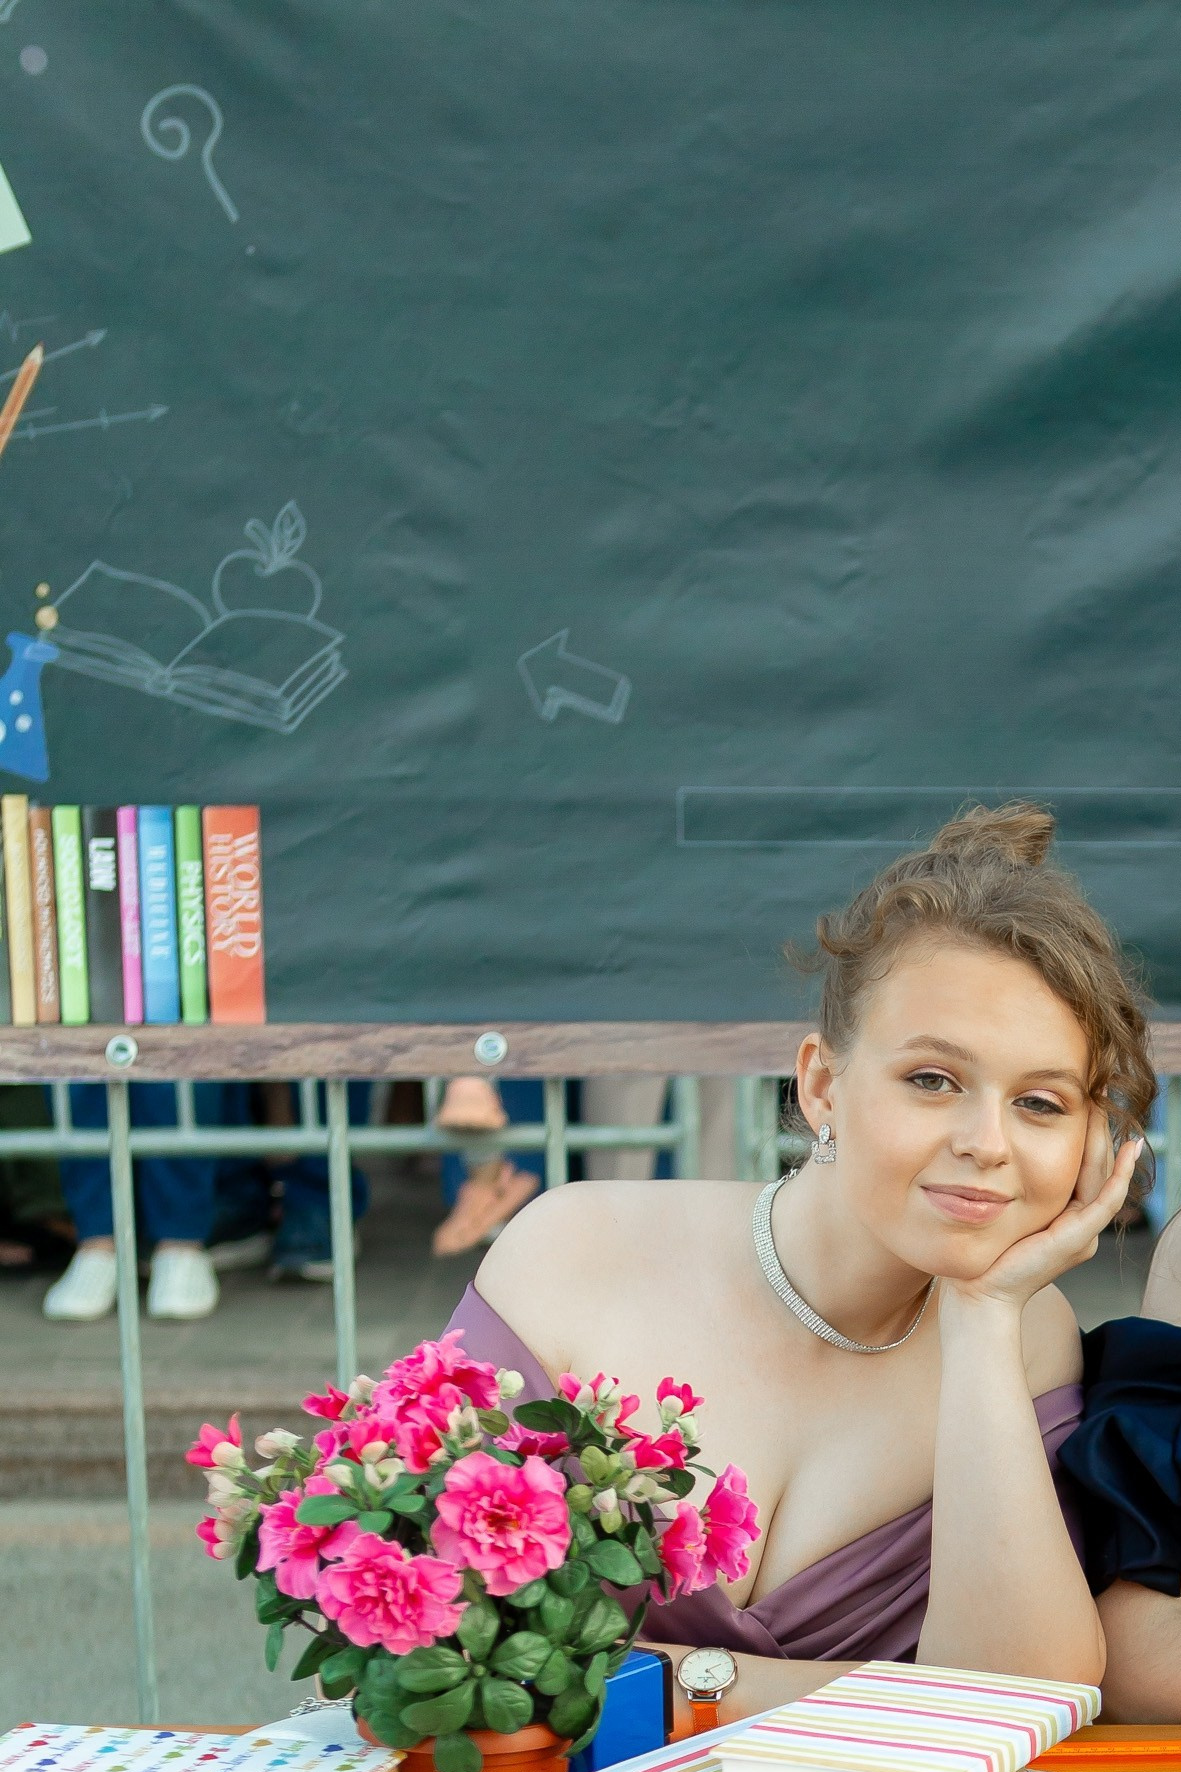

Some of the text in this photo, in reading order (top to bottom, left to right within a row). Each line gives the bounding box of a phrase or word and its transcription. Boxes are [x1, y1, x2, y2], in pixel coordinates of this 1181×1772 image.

[179, 860, 206, 967] PHYSICS
[208, 832, 238, 952] HISTORY
[231, 830, 263, 959] WORLD
